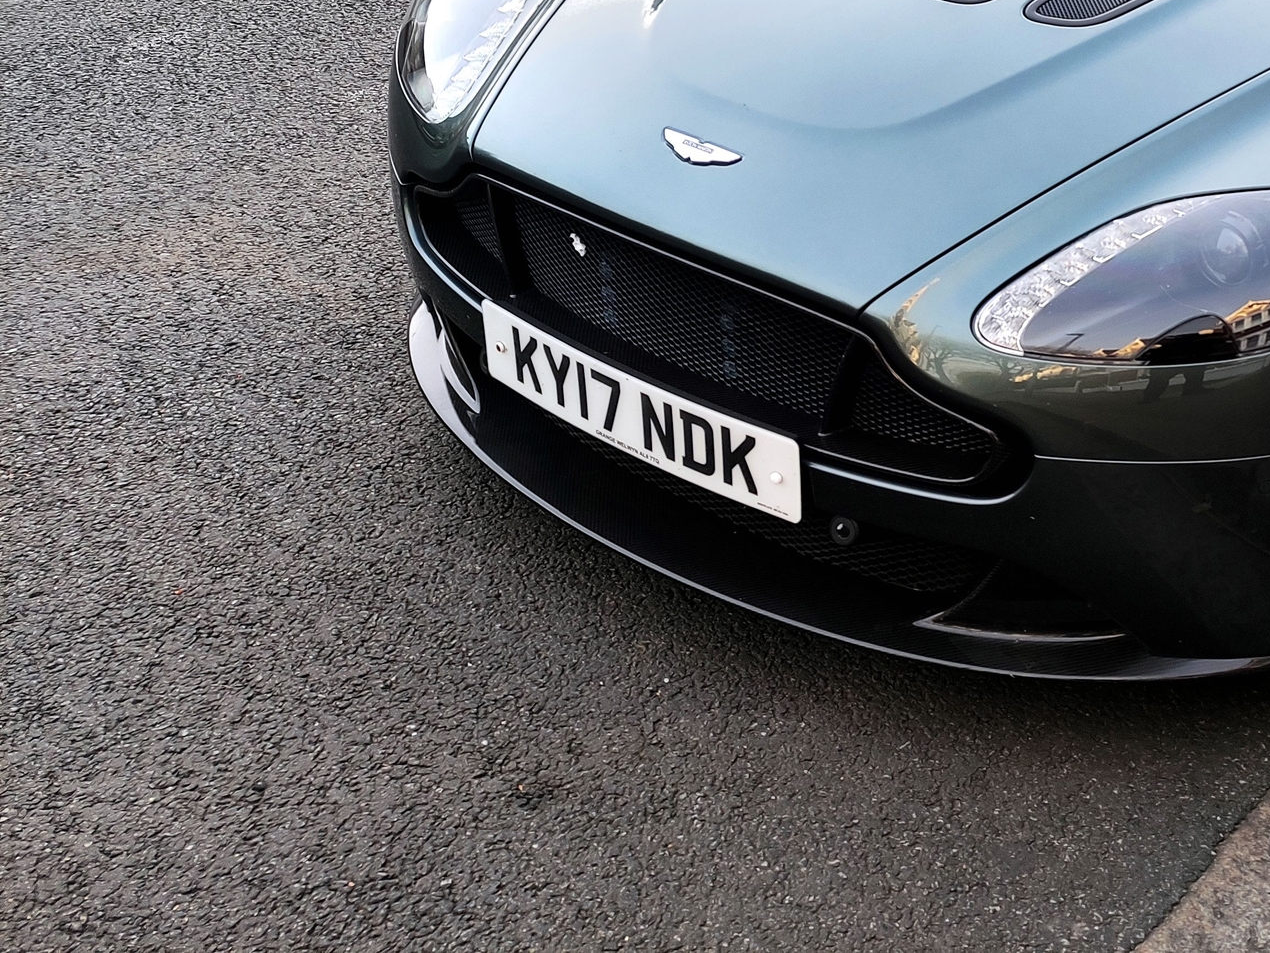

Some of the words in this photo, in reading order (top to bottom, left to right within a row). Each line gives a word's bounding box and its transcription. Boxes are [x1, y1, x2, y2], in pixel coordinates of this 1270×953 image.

[512, 325, 621, 432] KY17
[640, 391, 758, 496] NDK
[595, 429, 616, 444] GRANGE
[617, 440, 639, 455] WELWYN
